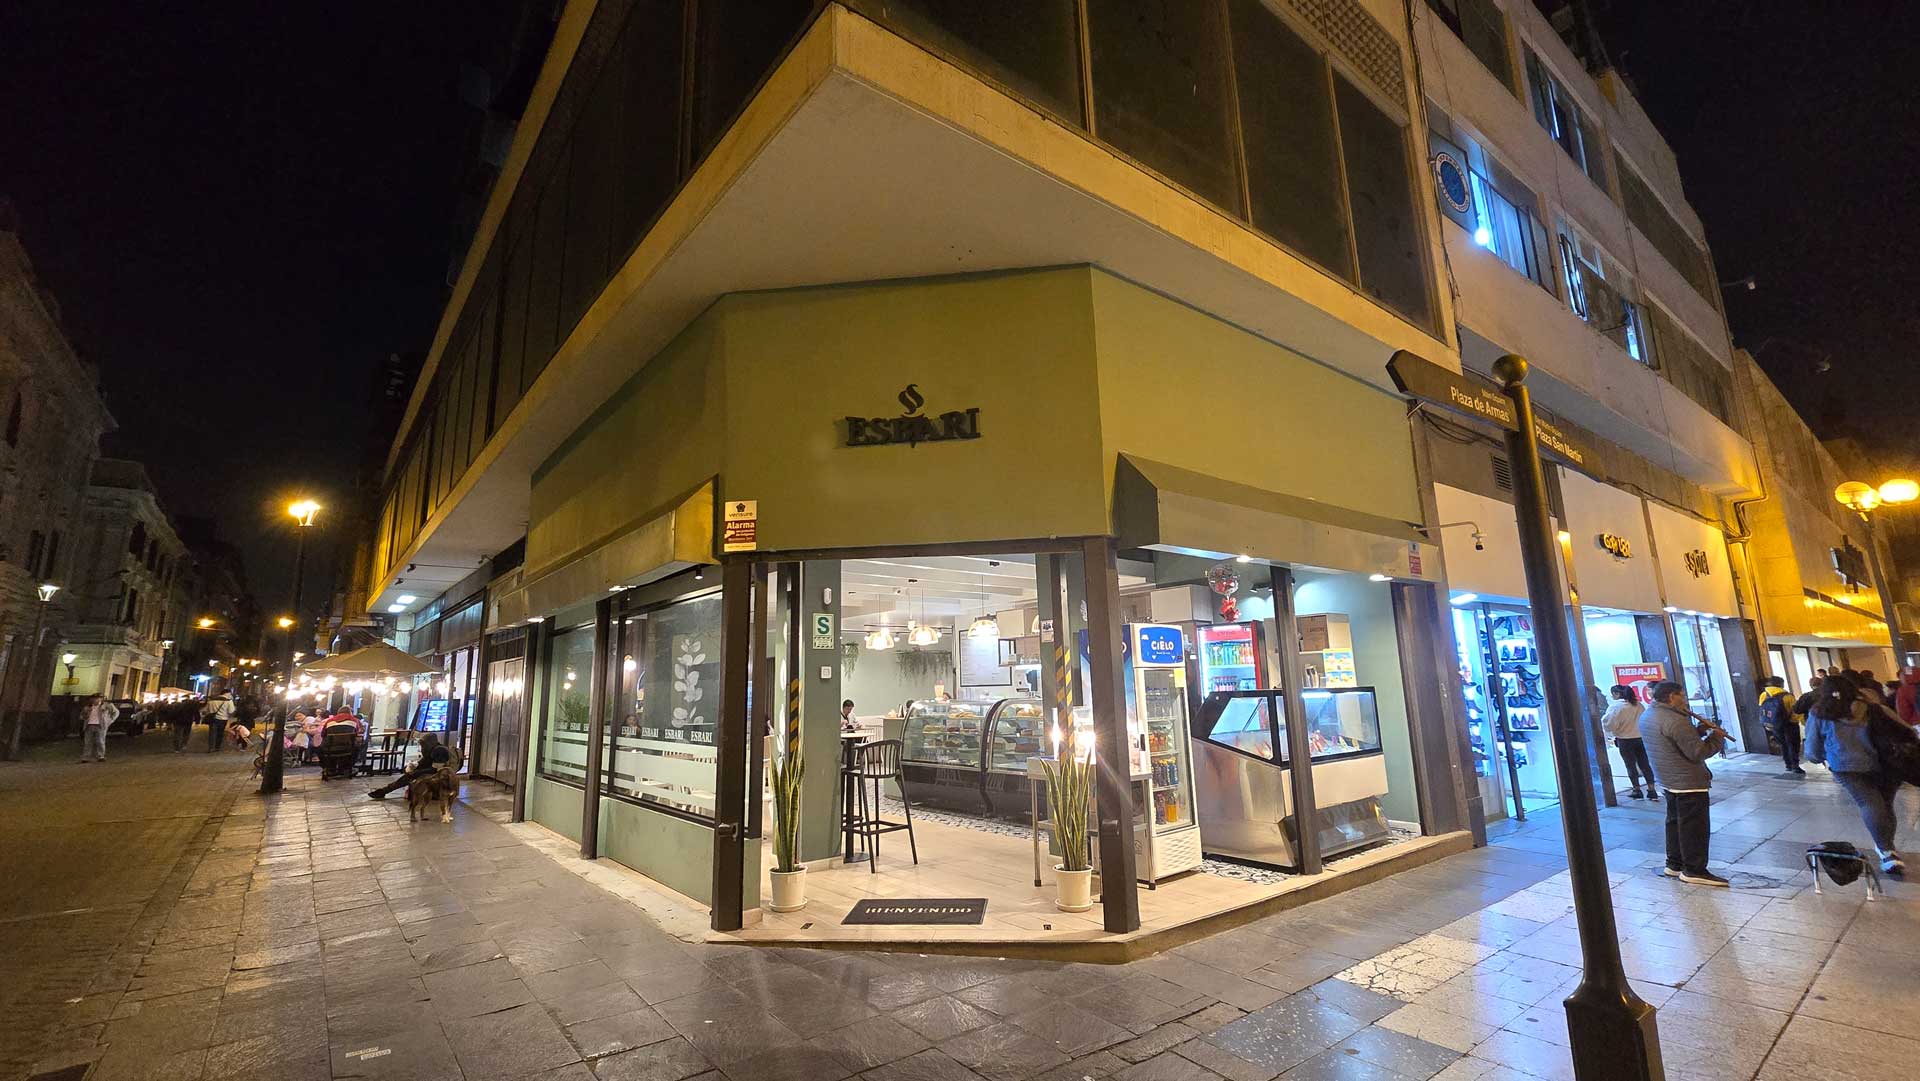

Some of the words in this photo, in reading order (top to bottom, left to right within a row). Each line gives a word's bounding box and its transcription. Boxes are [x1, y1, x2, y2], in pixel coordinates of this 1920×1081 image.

[1450, 386, 1474, 408] Plaza
[1474, 397, 1485, 413] de
[1485, 401, 1510, 423] Armas
[845, 407, 981, 447] ESBARI
[1535, 425, 1552, 446] Plaza
[1552, 436, 1565, 454] San
[817, 616, 830, 634] S
[1151, 640, 1174, 651] CIELO
[1618, 667, 1658, 676] REBAJA
[641, 727, 659, 738] ESBARI
[664, 729, 684, 740] ESBARI
[690, 730, 713, 743] ESBARI
